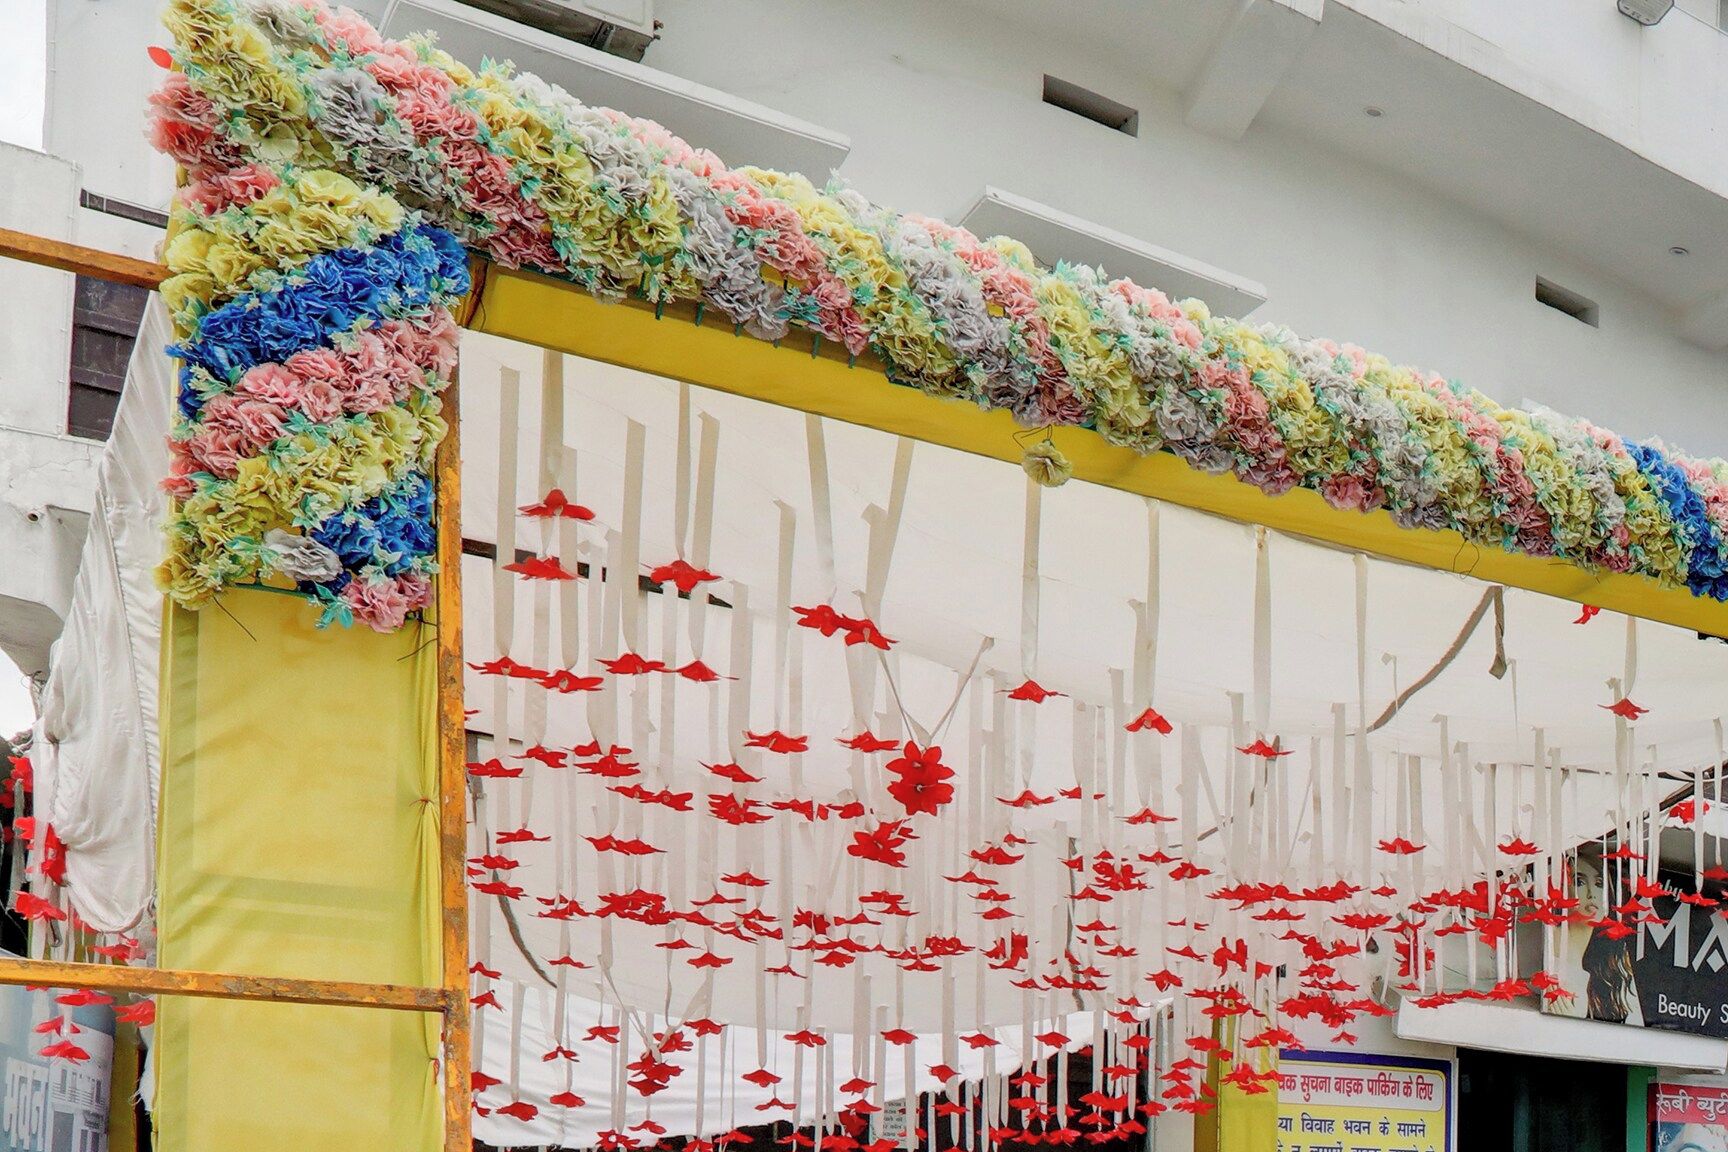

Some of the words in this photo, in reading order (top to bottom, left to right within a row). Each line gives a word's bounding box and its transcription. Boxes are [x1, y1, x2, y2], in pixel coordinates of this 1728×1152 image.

[1658, 994, 1711, 1026] Beauty
[1301, 1074, 1331, 1102] सुचना
[1334, 1077, 1363, 1097] बाइक
[1367, 1072, 1400, 1098] पार्किंग
[1403, 1075, 1413, 1098] के
[1416, 1075, 1433, 1101] लिए
[1656, 1089, 1694, 1115] रूबी
[1301, 1112, 1335, 1134] विवाह
[1343, 1120, 1371, 1135] भवन
[1379, 1117, 1390, 1136] के
[1397, 1119, 1426, 1138] सामने
